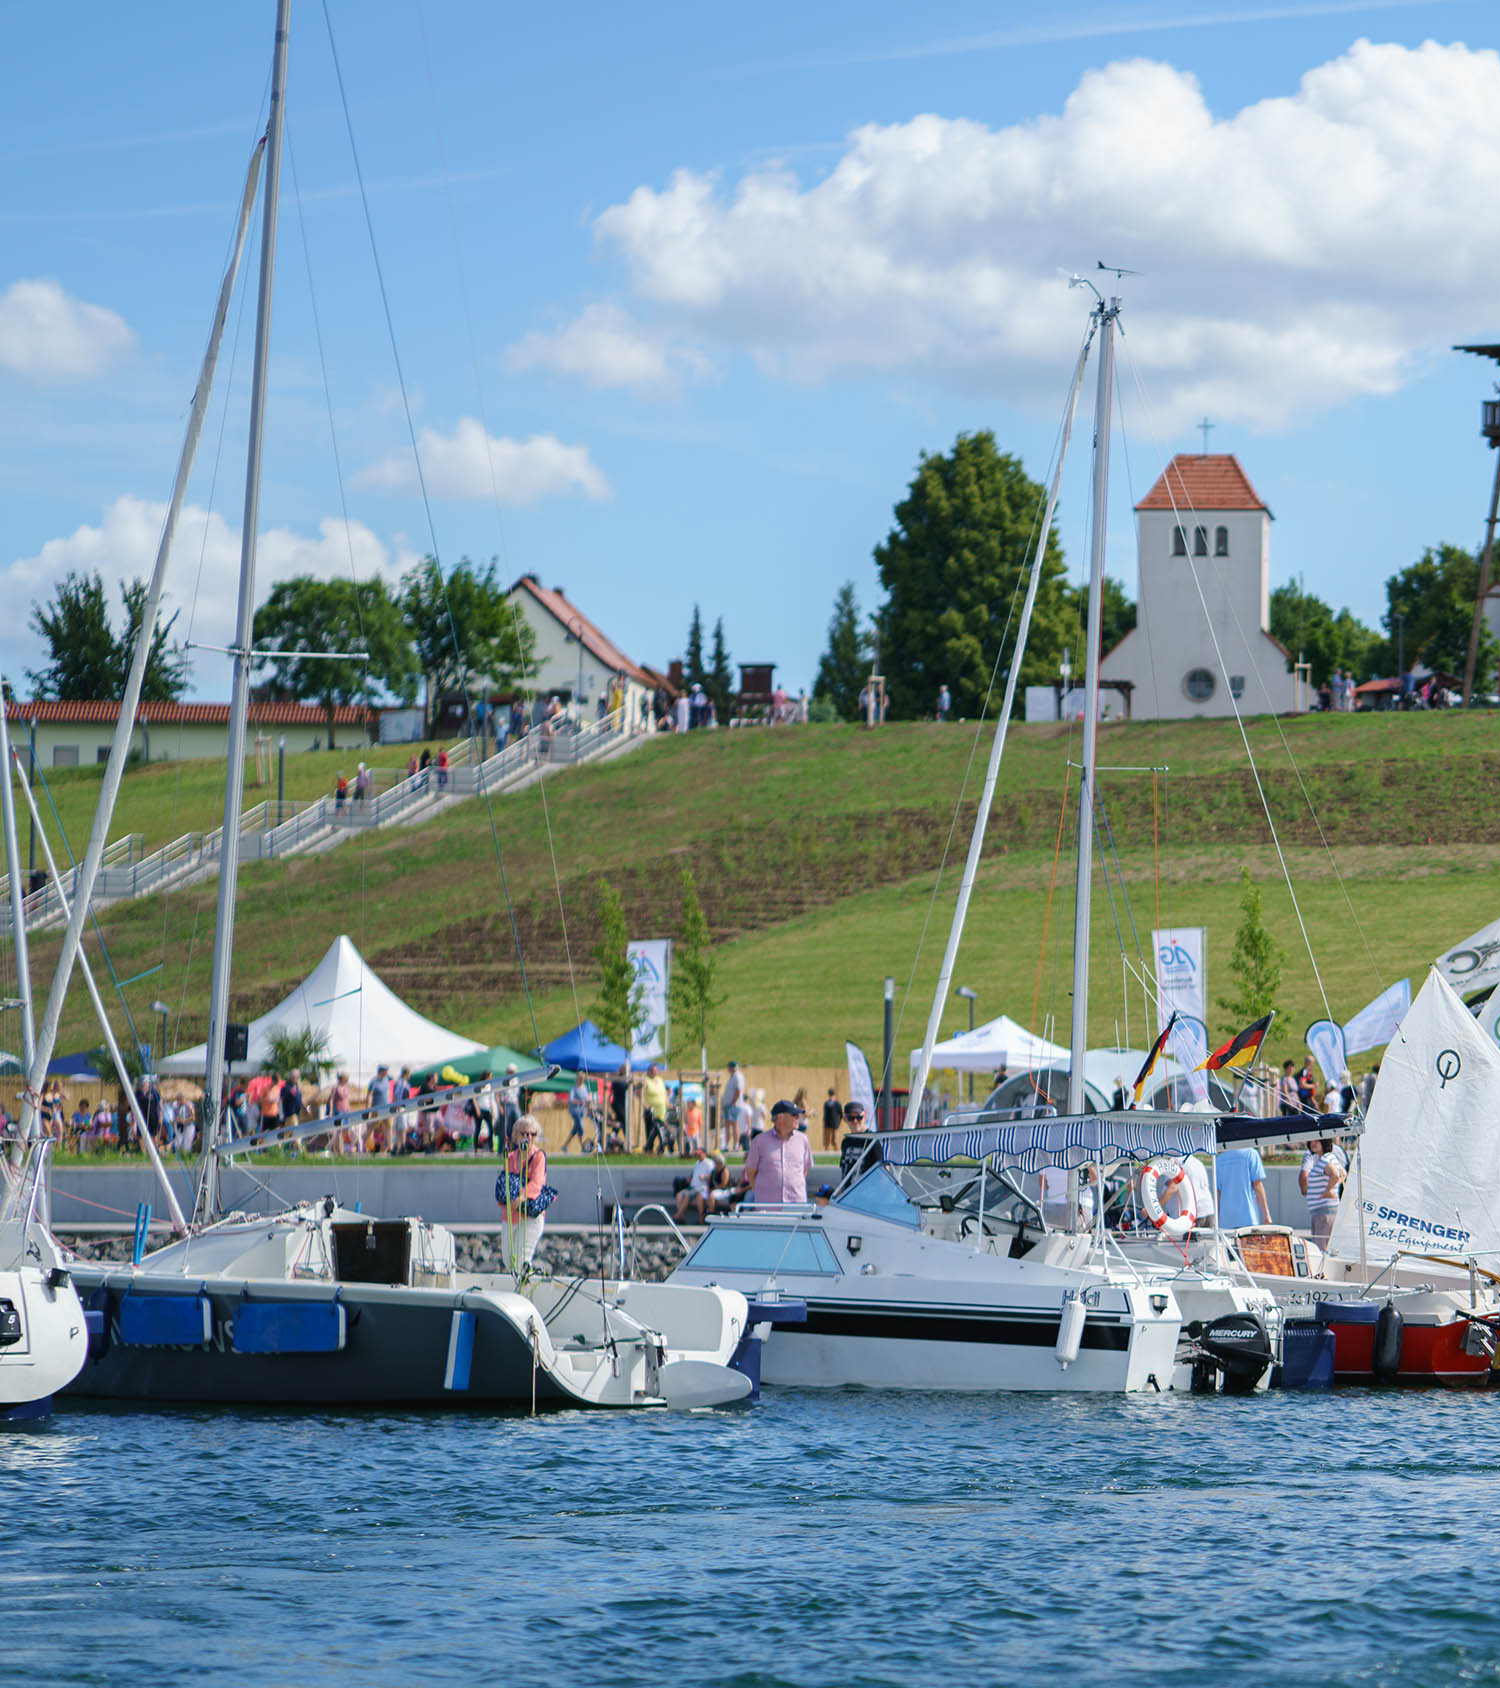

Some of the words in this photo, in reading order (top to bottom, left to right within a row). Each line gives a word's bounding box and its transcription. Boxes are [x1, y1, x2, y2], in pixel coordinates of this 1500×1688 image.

[1377, 1205, 1471, 1243] SPRENGER
[1368, 1221, 1465, 1252] Boat-Equipment
[7, 1314, 16, 1324] 5
[1209, 1328, 1258, 1339] MERCURY
